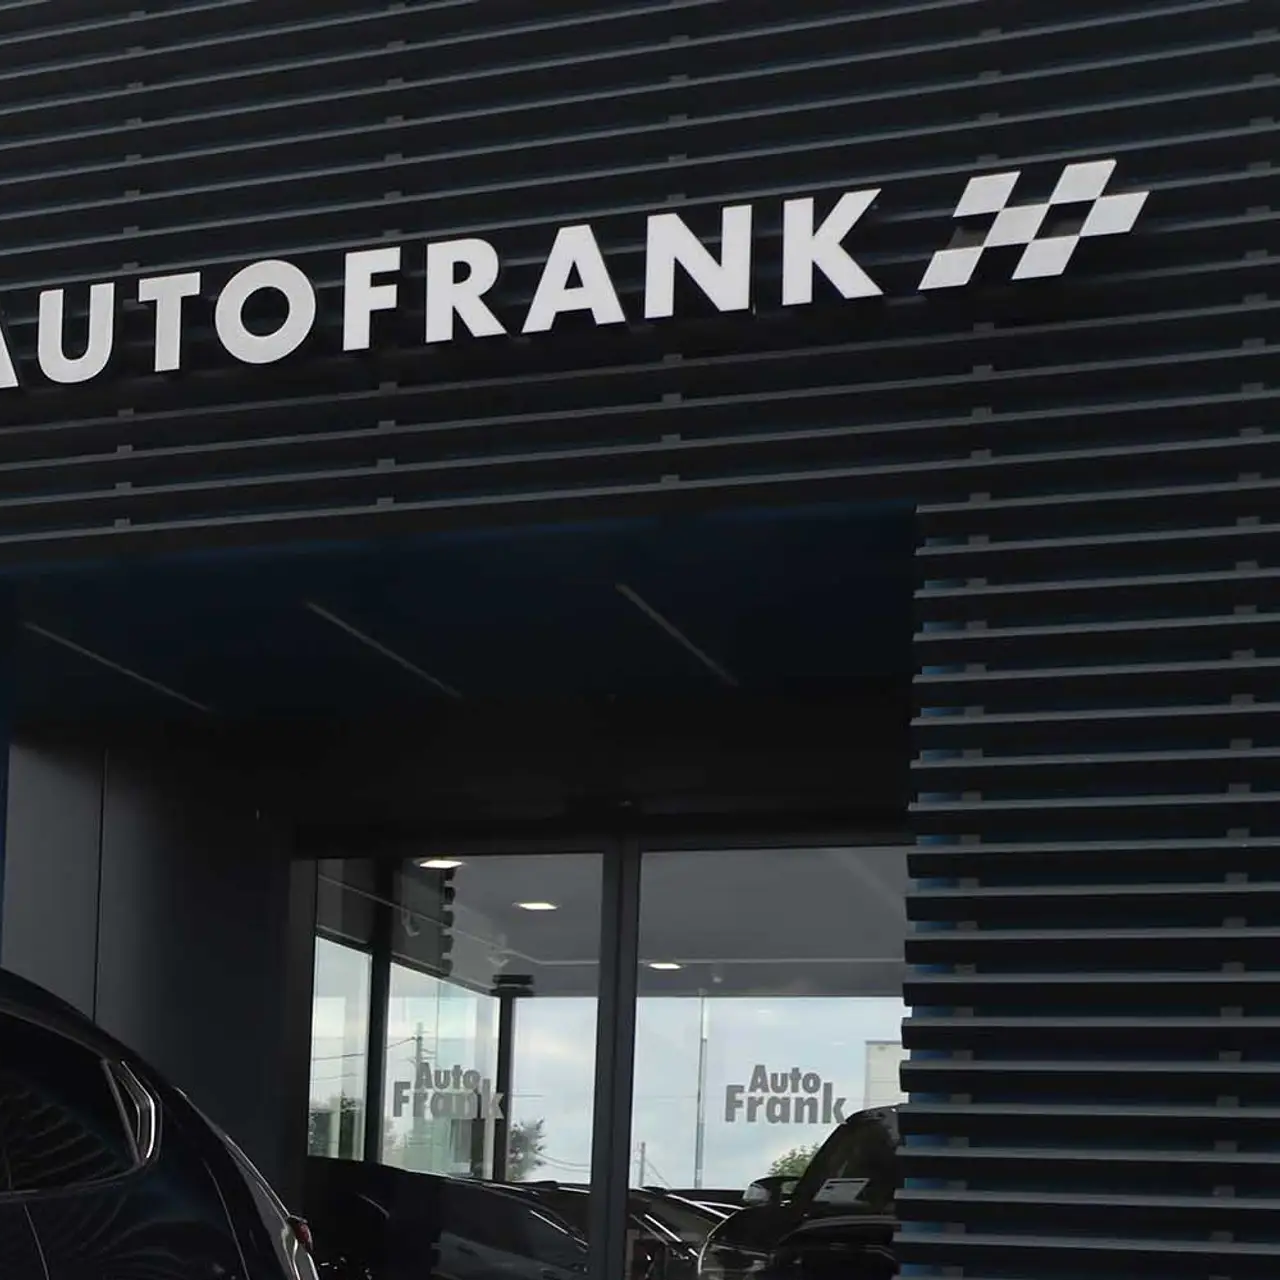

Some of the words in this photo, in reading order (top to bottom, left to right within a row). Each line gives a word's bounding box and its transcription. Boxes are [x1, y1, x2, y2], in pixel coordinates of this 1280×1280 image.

[414, 1062, 481, 1089] Auto
[748, 1064, 821, 1093] Auto
[393, 1079, 505, 1119] Frank
[725, 1082, 847, 1124] Frank
